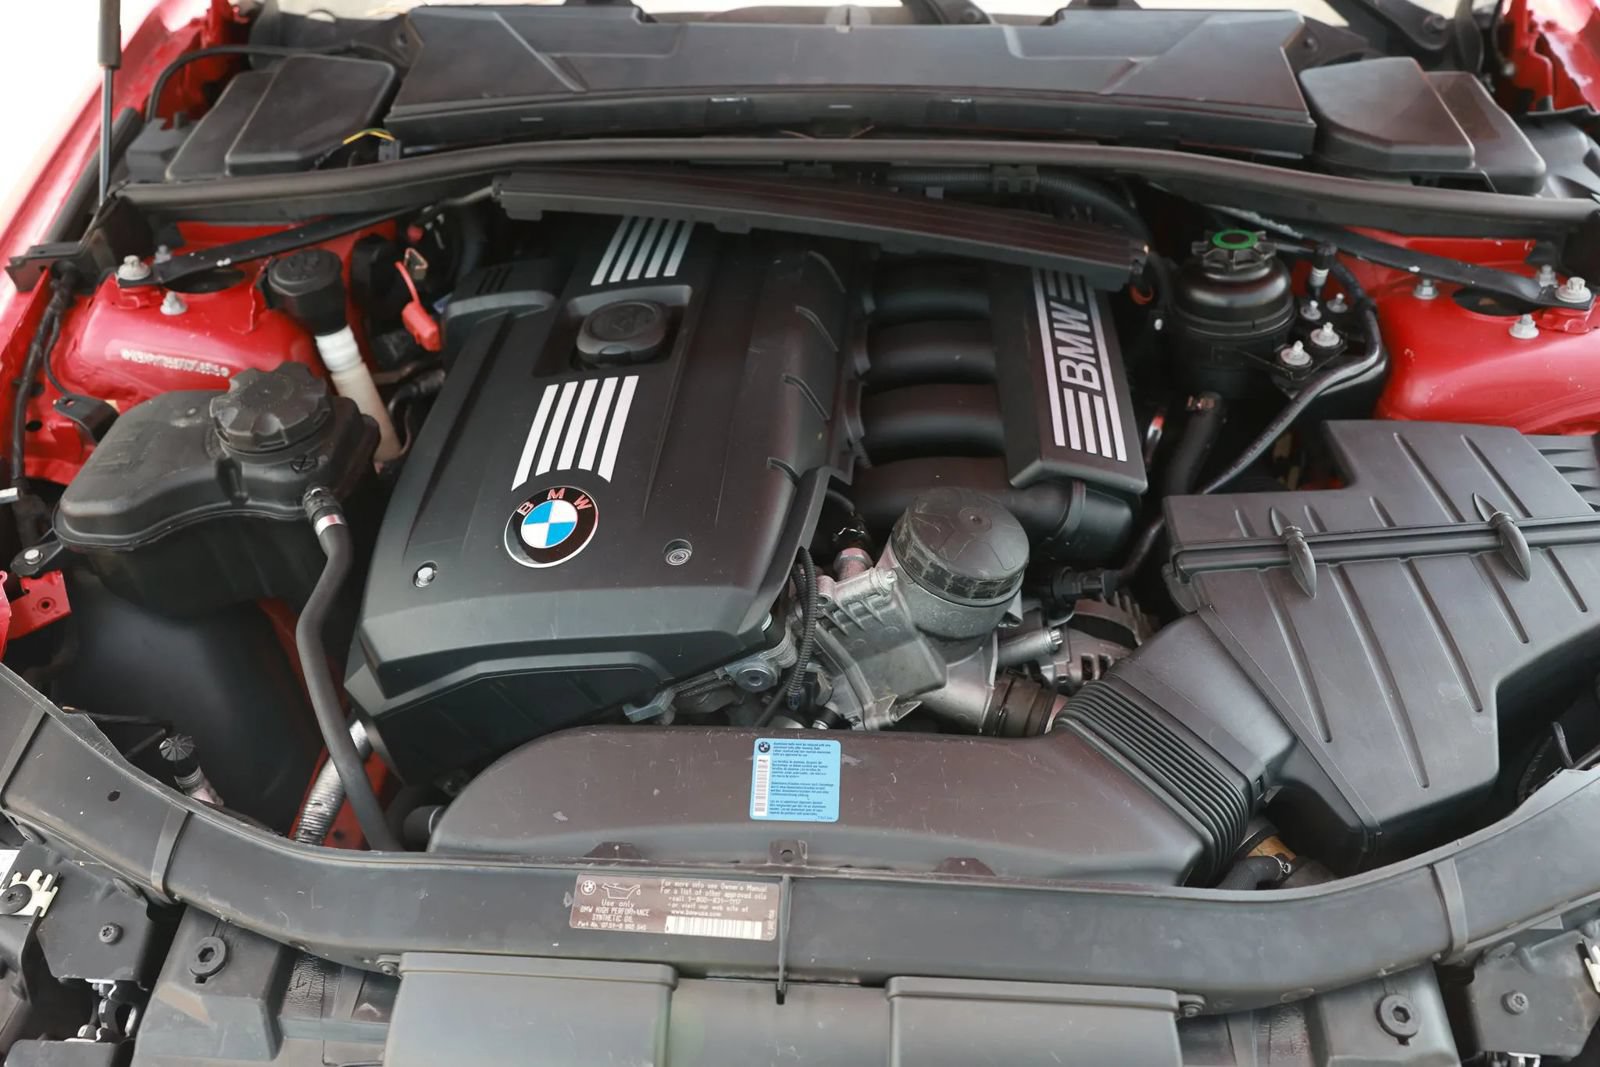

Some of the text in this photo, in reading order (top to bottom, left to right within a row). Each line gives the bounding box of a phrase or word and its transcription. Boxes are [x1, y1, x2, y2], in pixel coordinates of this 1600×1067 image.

[1049, 300, 1101, 391] BMW
[517, 487, 592, 516] BMW
[601, 899, 634, 908] Use only
